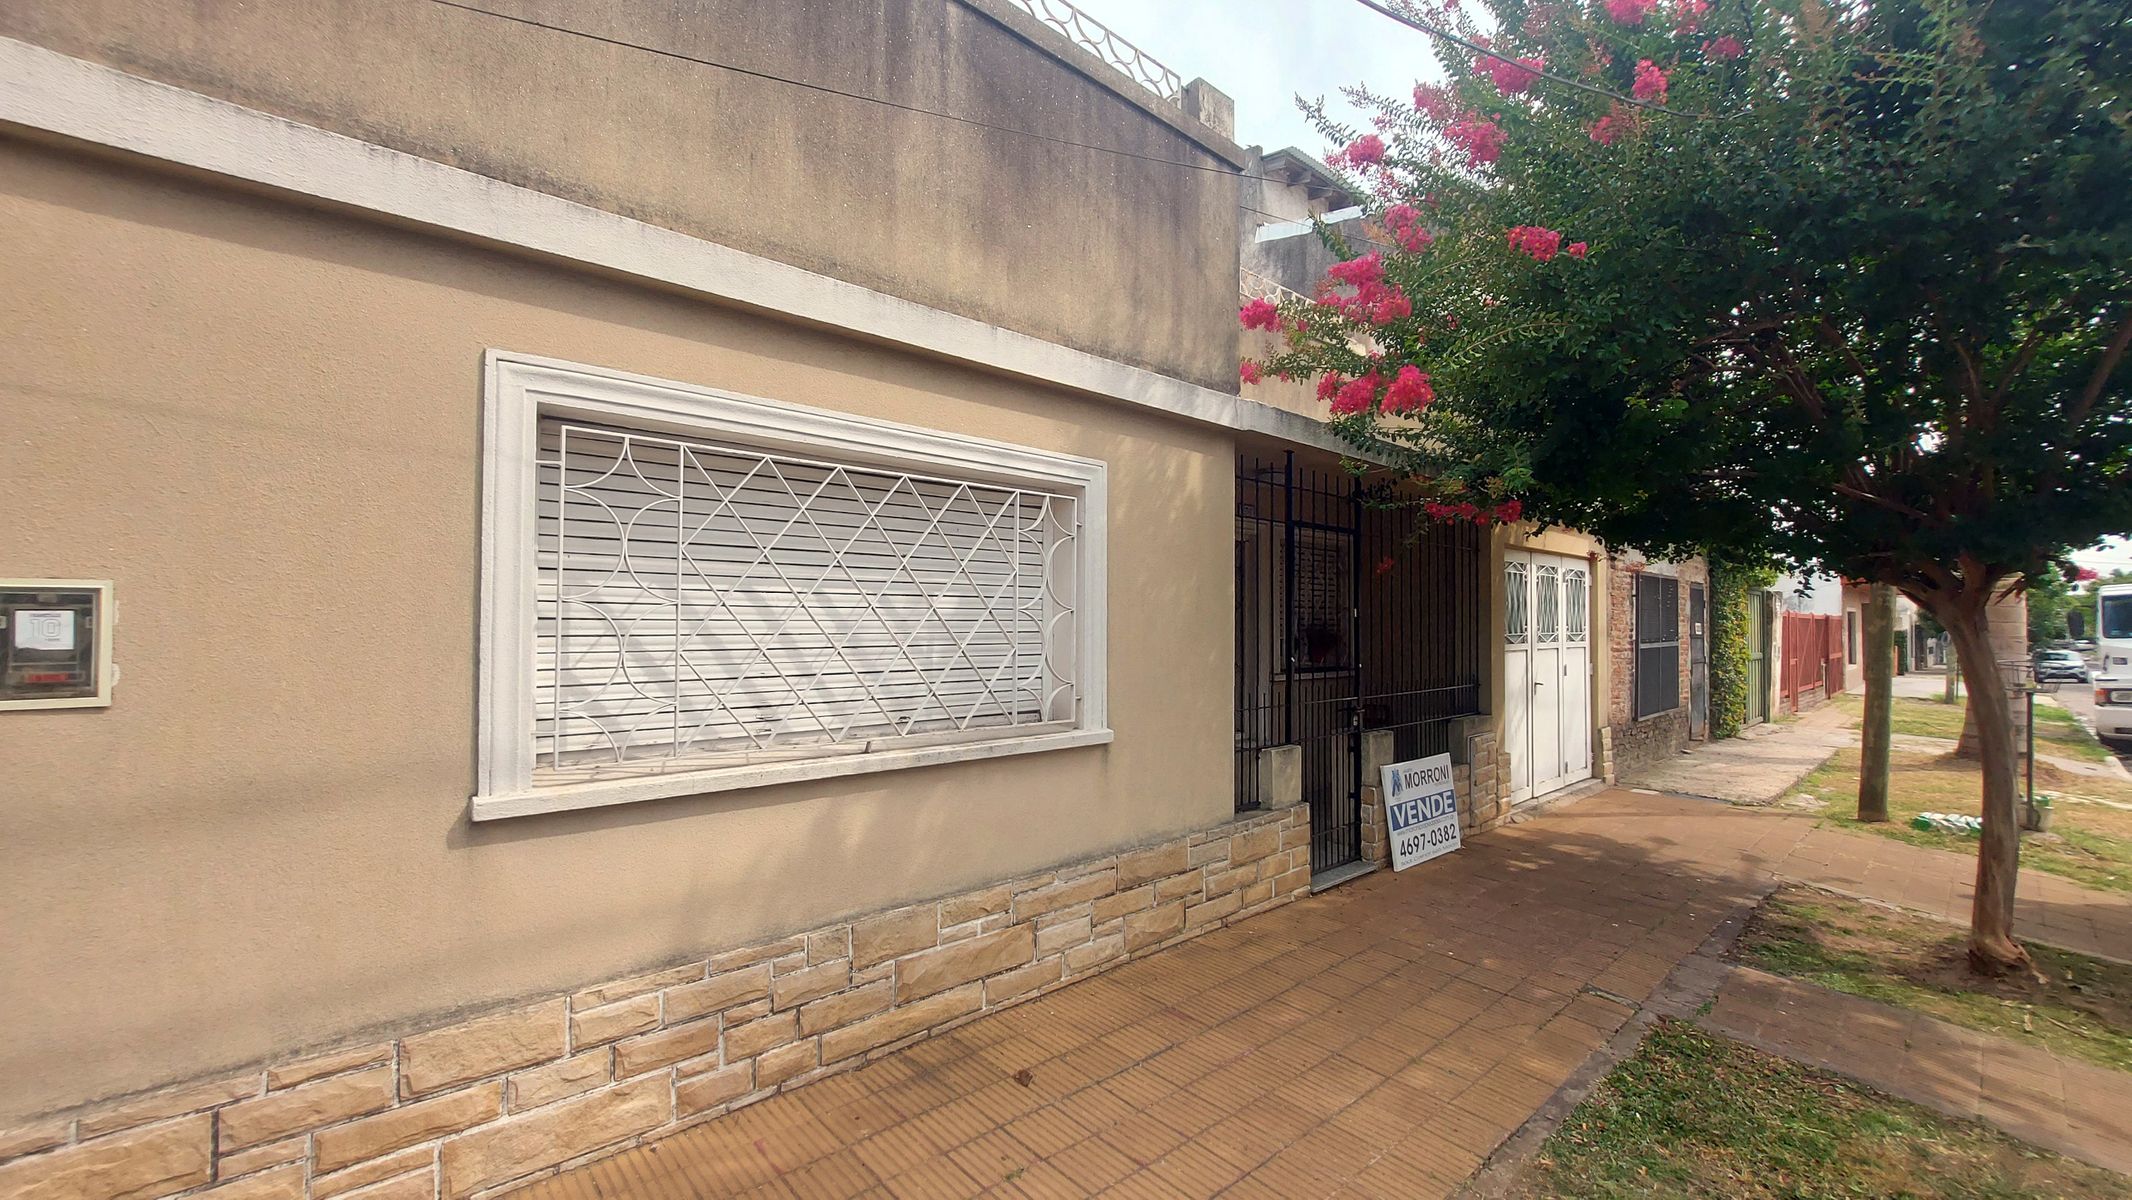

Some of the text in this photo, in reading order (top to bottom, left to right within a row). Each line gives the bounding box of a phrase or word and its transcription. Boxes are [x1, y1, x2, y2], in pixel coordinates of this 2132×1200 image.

[1404, 764, 1450, 790] MORRONI
[1393, 791, 1454, 827] VENDE
[1400, 823, 1457, 857] 4697-0382
